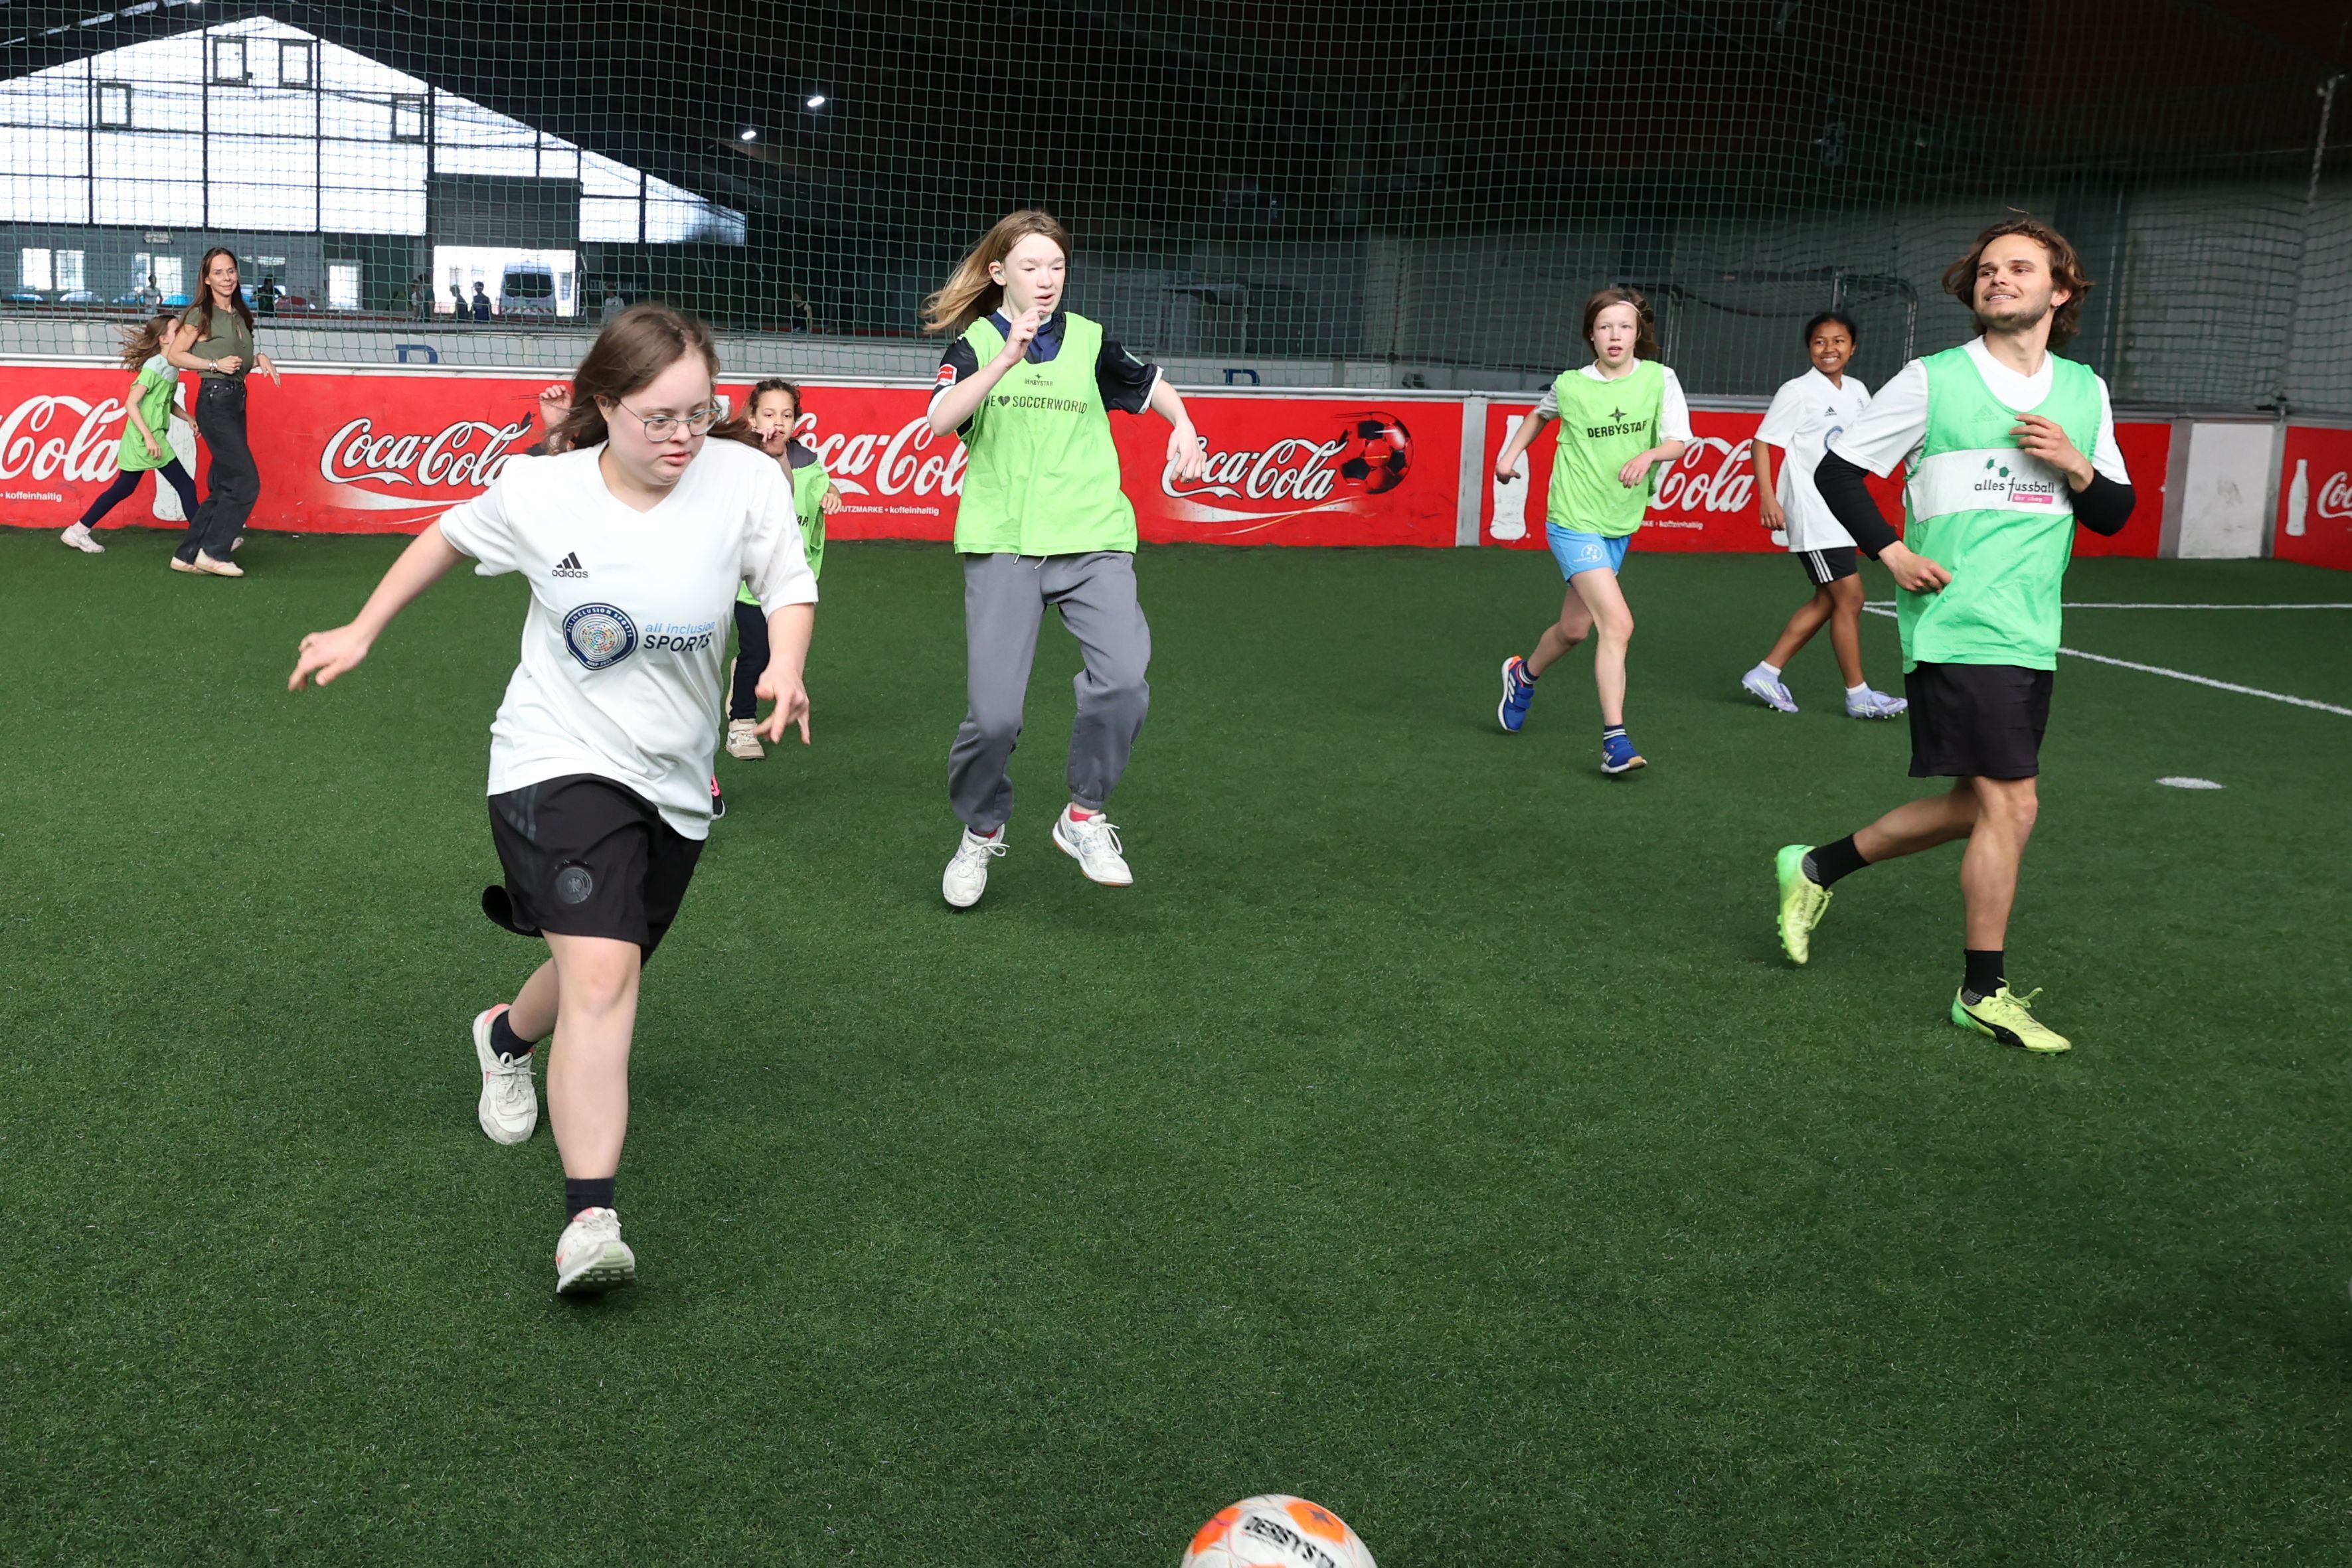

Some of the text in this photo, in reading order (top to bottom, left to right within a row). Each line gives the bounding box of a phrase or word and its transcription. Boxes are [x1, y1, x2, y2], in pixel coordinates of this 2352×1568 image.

[1013, 396, 1088, 414] SOCCERWORLD
[1161, 435, 1348, 501] Cca-Cola
[5, 491, 62, 503] koffeinhaltig
[1974, 477, 2055, 501] alles fussball
[839, 505, 940, 516] UTZMARKE koffeinhaltig
[552, 568, 589, 578] adidas
[571, 607, 612, 622] INCLUSION
[614, 613, 633, 637] SPORTS
[645, 620, 716, 634] all inclusion
[643, 632, 712, 652] SPORTS
